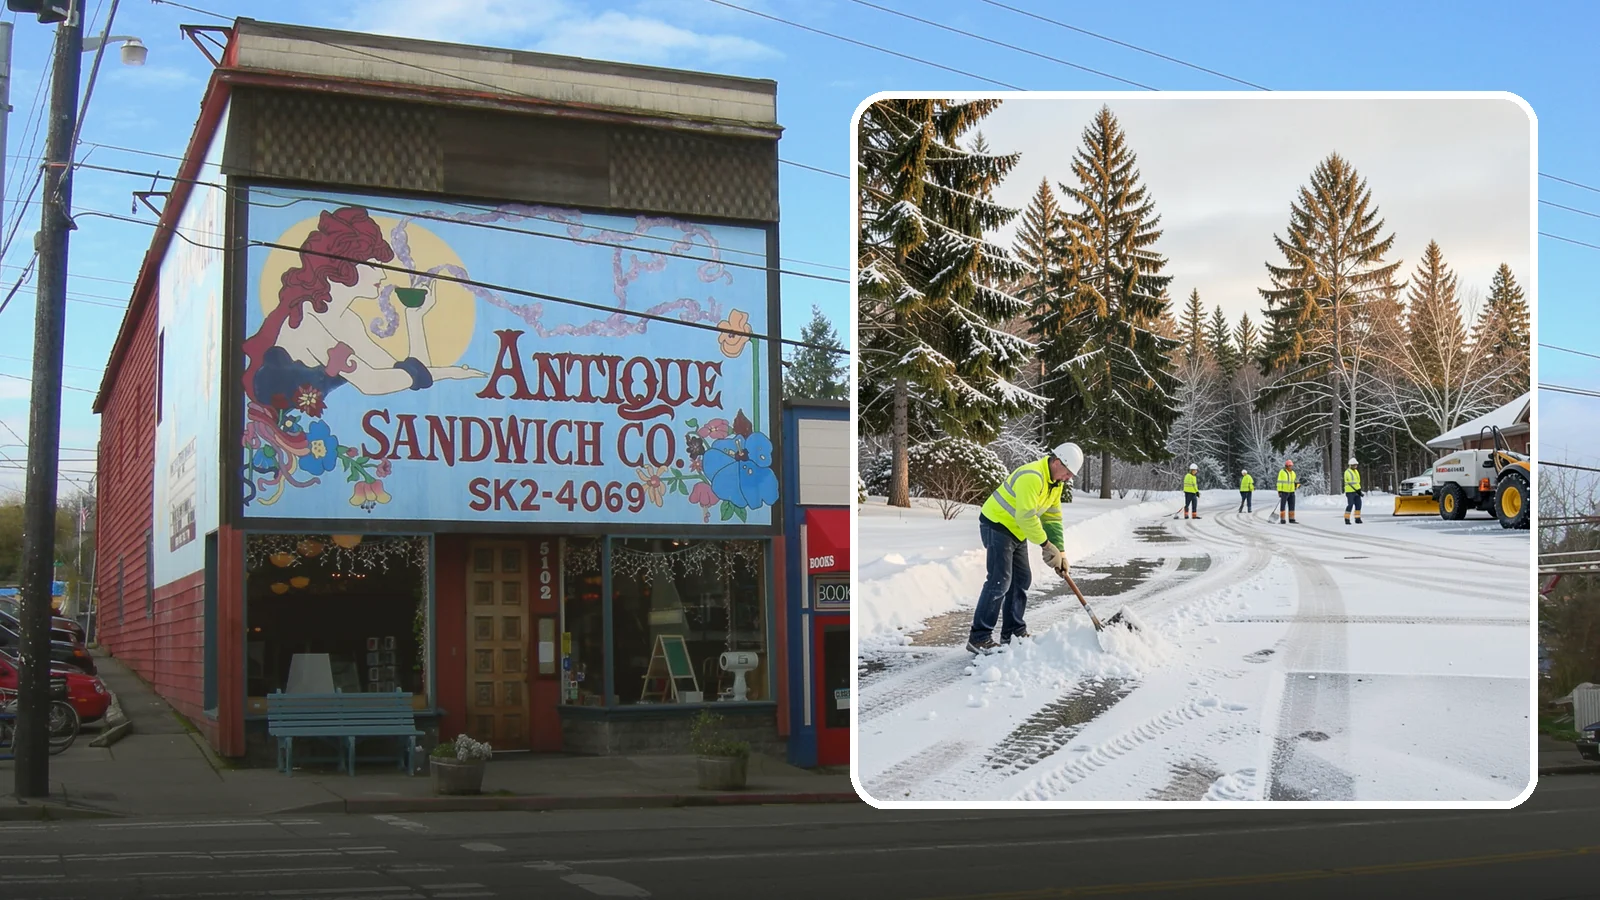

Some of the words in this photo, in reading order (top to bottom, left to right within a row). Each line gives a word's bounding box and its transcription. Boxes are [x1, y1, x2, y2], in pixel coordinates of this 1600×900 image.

[475, 329, 723, 420] ANTIQUE
[361, 408, 604, 467] SANDWICH
[617, 421, 684, 468] CO.
[468, 477, 646, 513] SK2-4069
[540, 542, 551, 599] 5102
[809, 555, 835, 569] BOOKS
